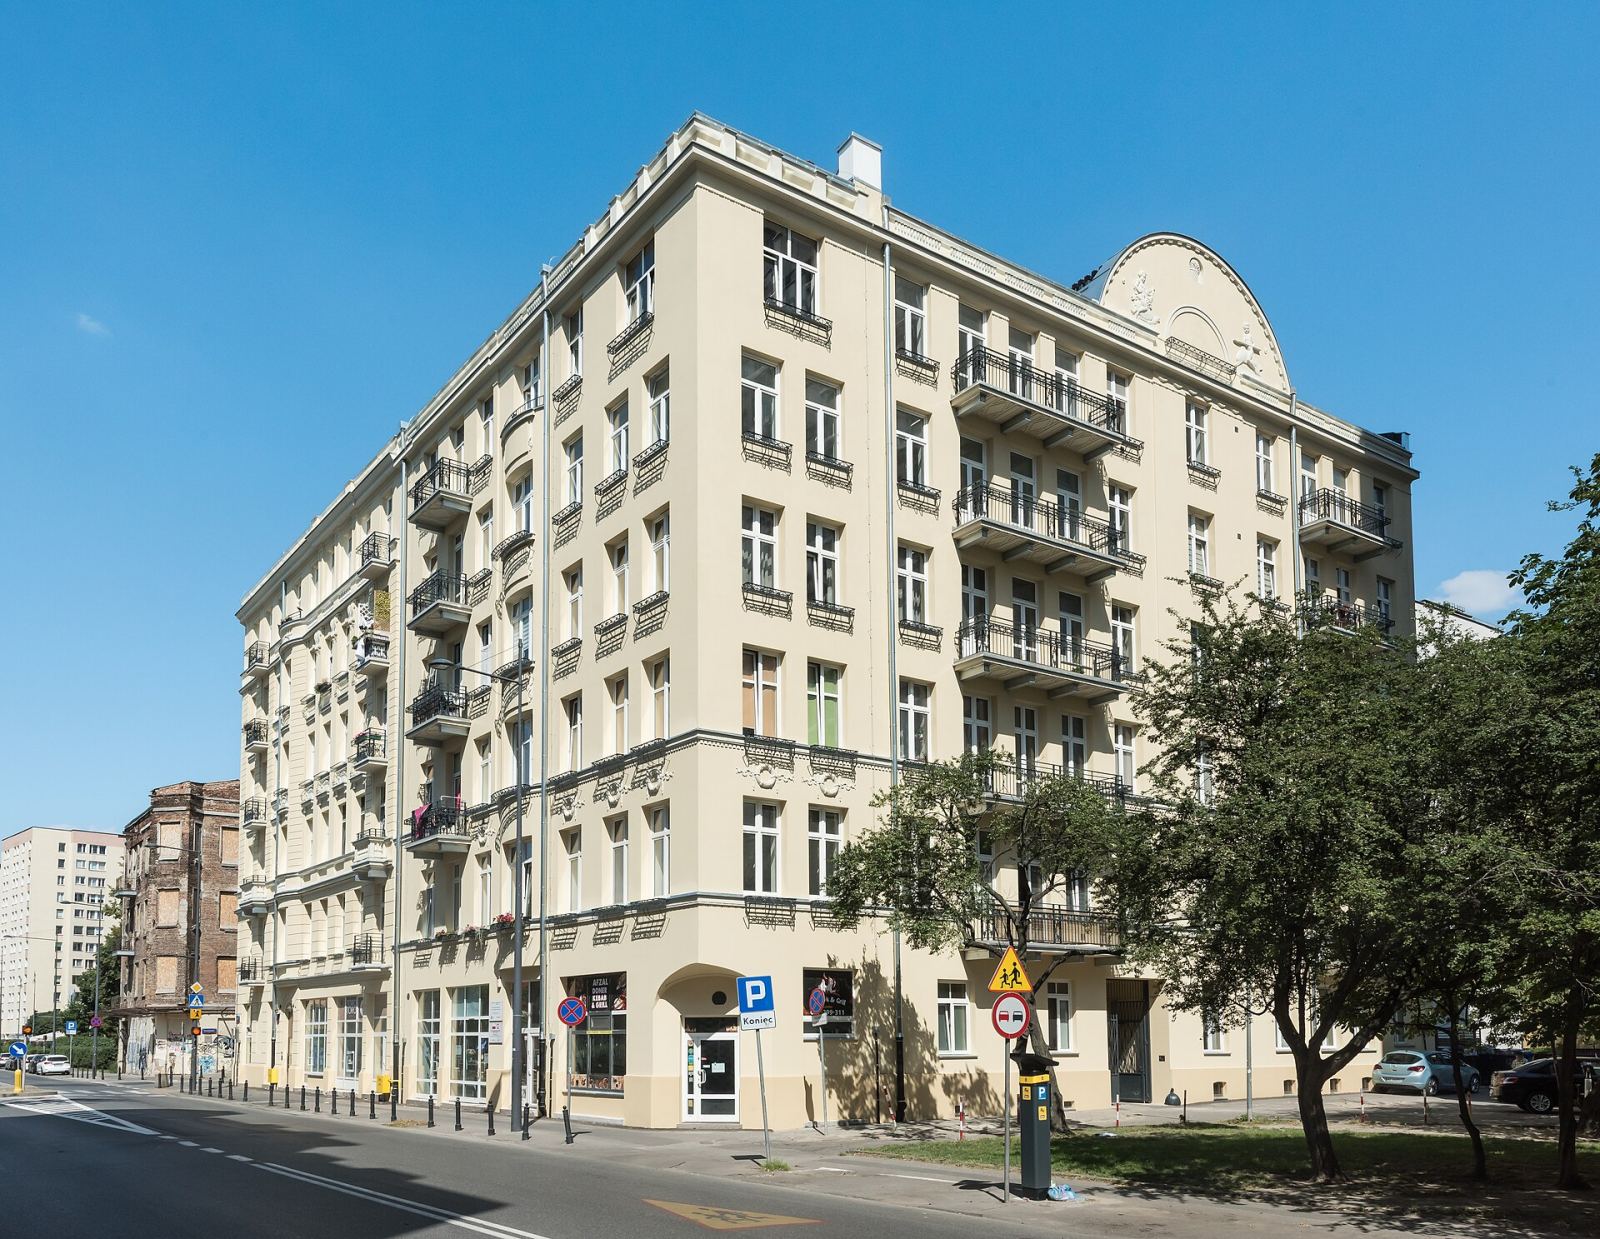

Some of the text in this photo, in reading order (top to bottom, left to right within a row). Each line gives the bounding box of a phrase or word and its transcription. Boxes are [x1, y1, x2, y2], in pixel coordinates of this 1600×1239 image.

[592, 978, 608, 986] AFZAL
[745, 980, 766, 1008] P
[743, 1016, 773, 1025] Koniec
[1038, 1086, 1046, 1098] P
